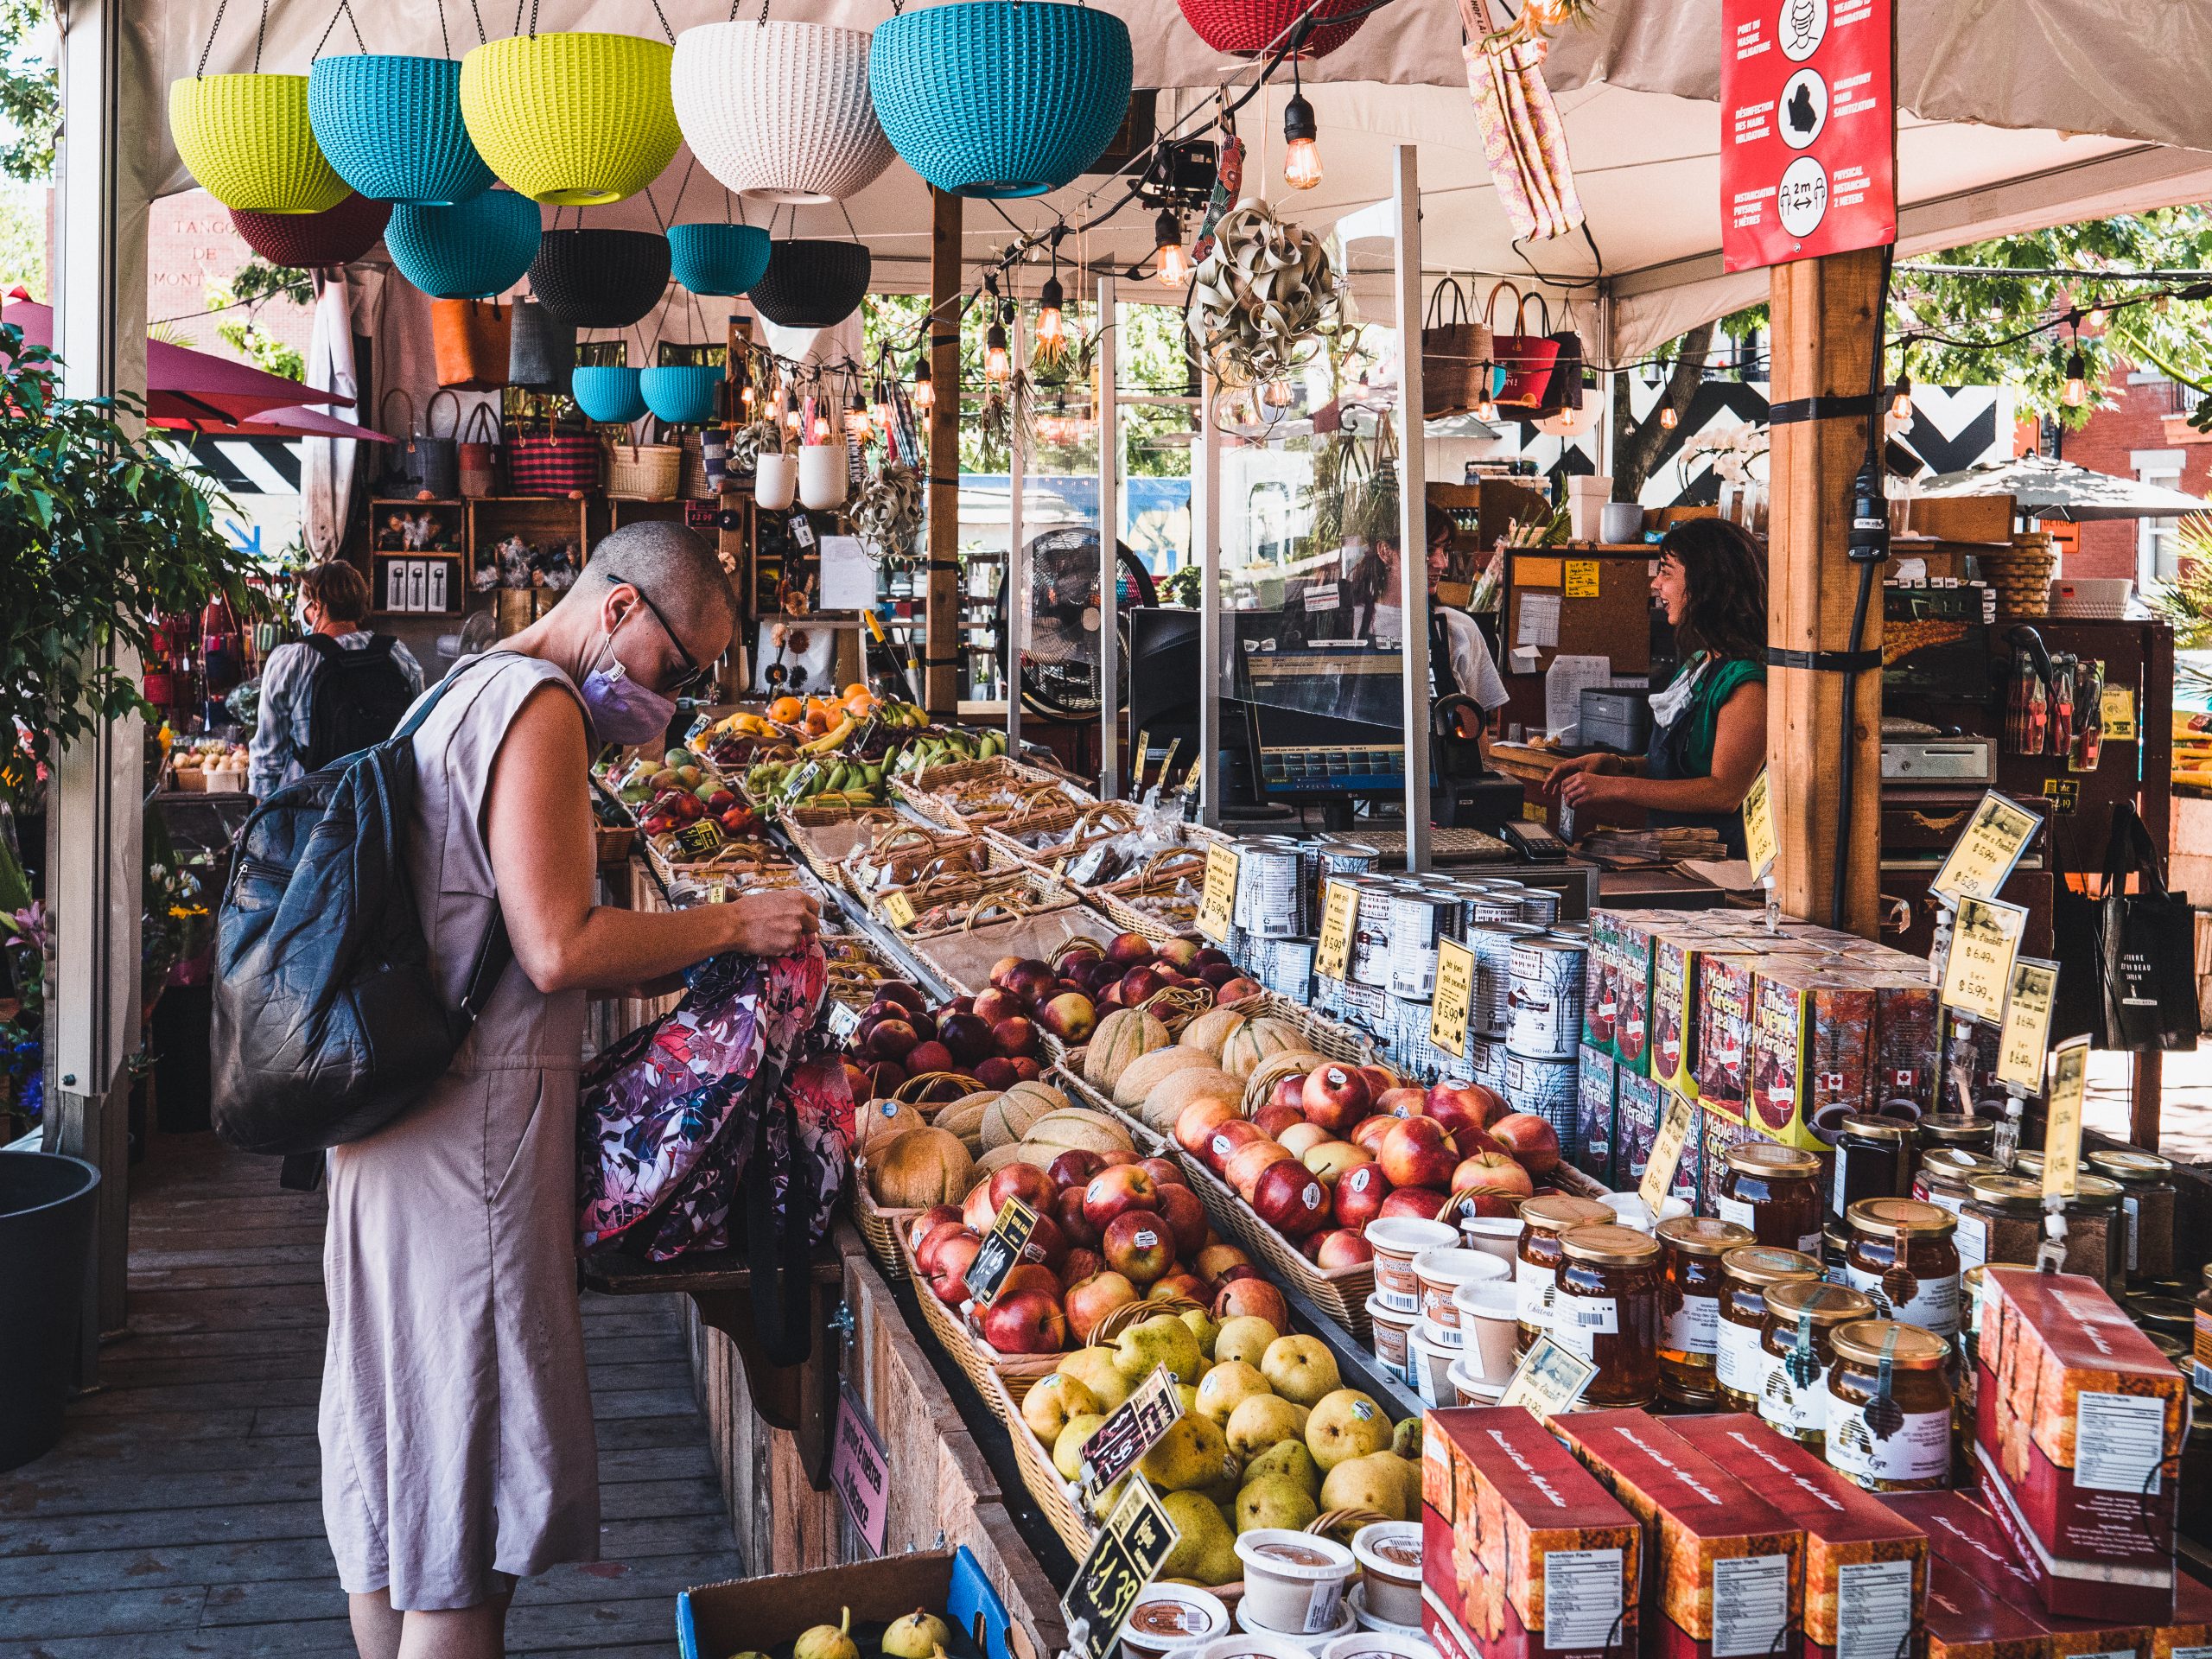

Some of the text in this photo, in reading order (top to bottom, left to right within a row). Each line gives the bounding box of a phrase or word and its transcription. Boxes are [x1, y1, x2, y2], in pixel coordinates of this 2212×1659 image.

[1738, 19, 1760, 35] PORT DU
[1834, 7, 1872, 29] MANDATORY
[1737, 32, 1760, 48] MASQUE
[1737, 41, 1771, 60] OBLIGATOIRE
[1834, 72, 1872, 92] MANDATORY
[1834, 91, 1852, 105] HAND
[1735, 100, 1774, 120] DÉSINFECTION
[1834, 98, 1876, 118] SANITIZATION
[1735, 116, 1764, 132] DES MAINS
[1735, 127, 1770, 144] OBLIGATOIRE
[1834, 166, 1864, 181] PHYSICAL
[1833, 177, 1871, 194] DISTANCING
[1734, 186, 1777, 204] DISTANCIATION
[1834, 194, 1864, 207] 2 METERS
[1733, 201, 1762, 216] PHYSIQUE
[174, 221, 233, 234] TANGO
[1733, 213, 1761, 229] 2 MÈTRES
[193, 247, 216, 260] DE
[1961, 875, 1979, 892] 5.29
[1974, 948, 1991, 963] 6.49
[1707, 966, 1736, 995] Maple
[1967, 982, 1987, 1000] 5.99
[1708, 987, 1742, 1019] Green
[1444, 1003, 1459, 1024] 5.99
[1713, 1011, 1728, 1031] tea
[1761, 1007, 1790, 1038] vert
[1580, 1055, 1608, 1083] Tisane
[1622, 1074, 1652, 1106] Tisane
[1706, 1112, 1732, 1142] Maple
[1707, 1134, 1726, 1160] Gre
[1710, 1160, 1725, 1177] tea
[857, 1434, 863, 1465] 2
[862, 1448, 883, 1497] mètres
[848, 1471, 869, 1531] distance
